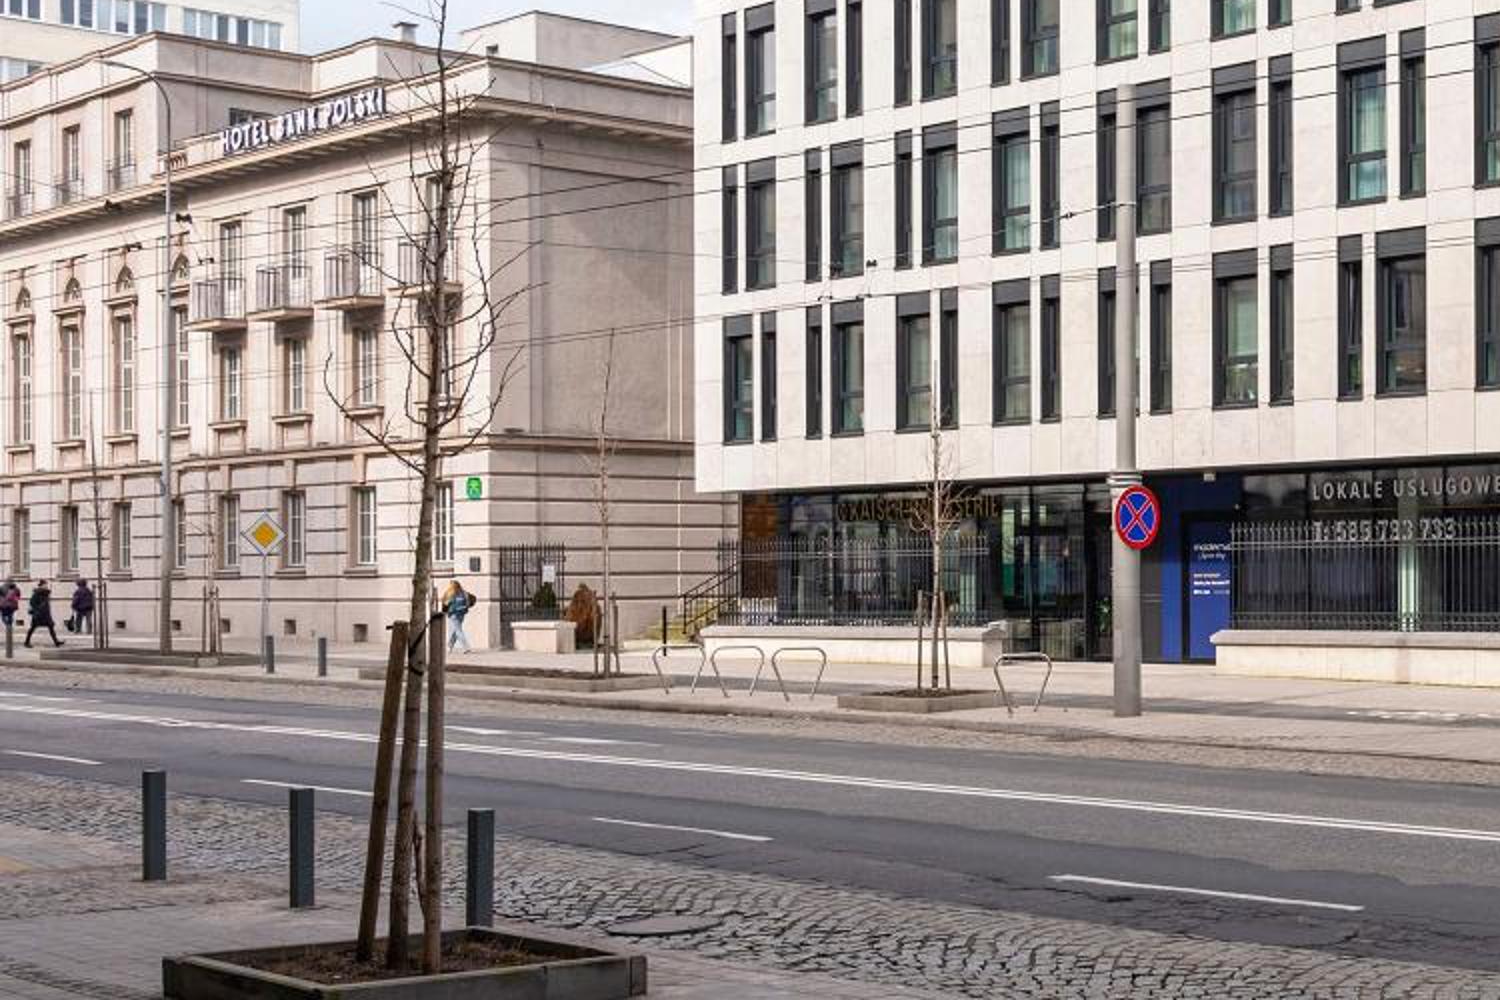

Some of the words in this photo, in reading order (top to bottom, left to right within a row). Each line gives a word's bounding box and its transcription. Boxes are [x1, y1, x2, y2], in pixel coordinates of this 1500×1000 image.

[222, 119, 270, 152] HOTEL
[273, 108, 317, 142] BANK
[318, 87, 386, 130] POLSKI
[1312, 480, 1384, 500] LOKALE
